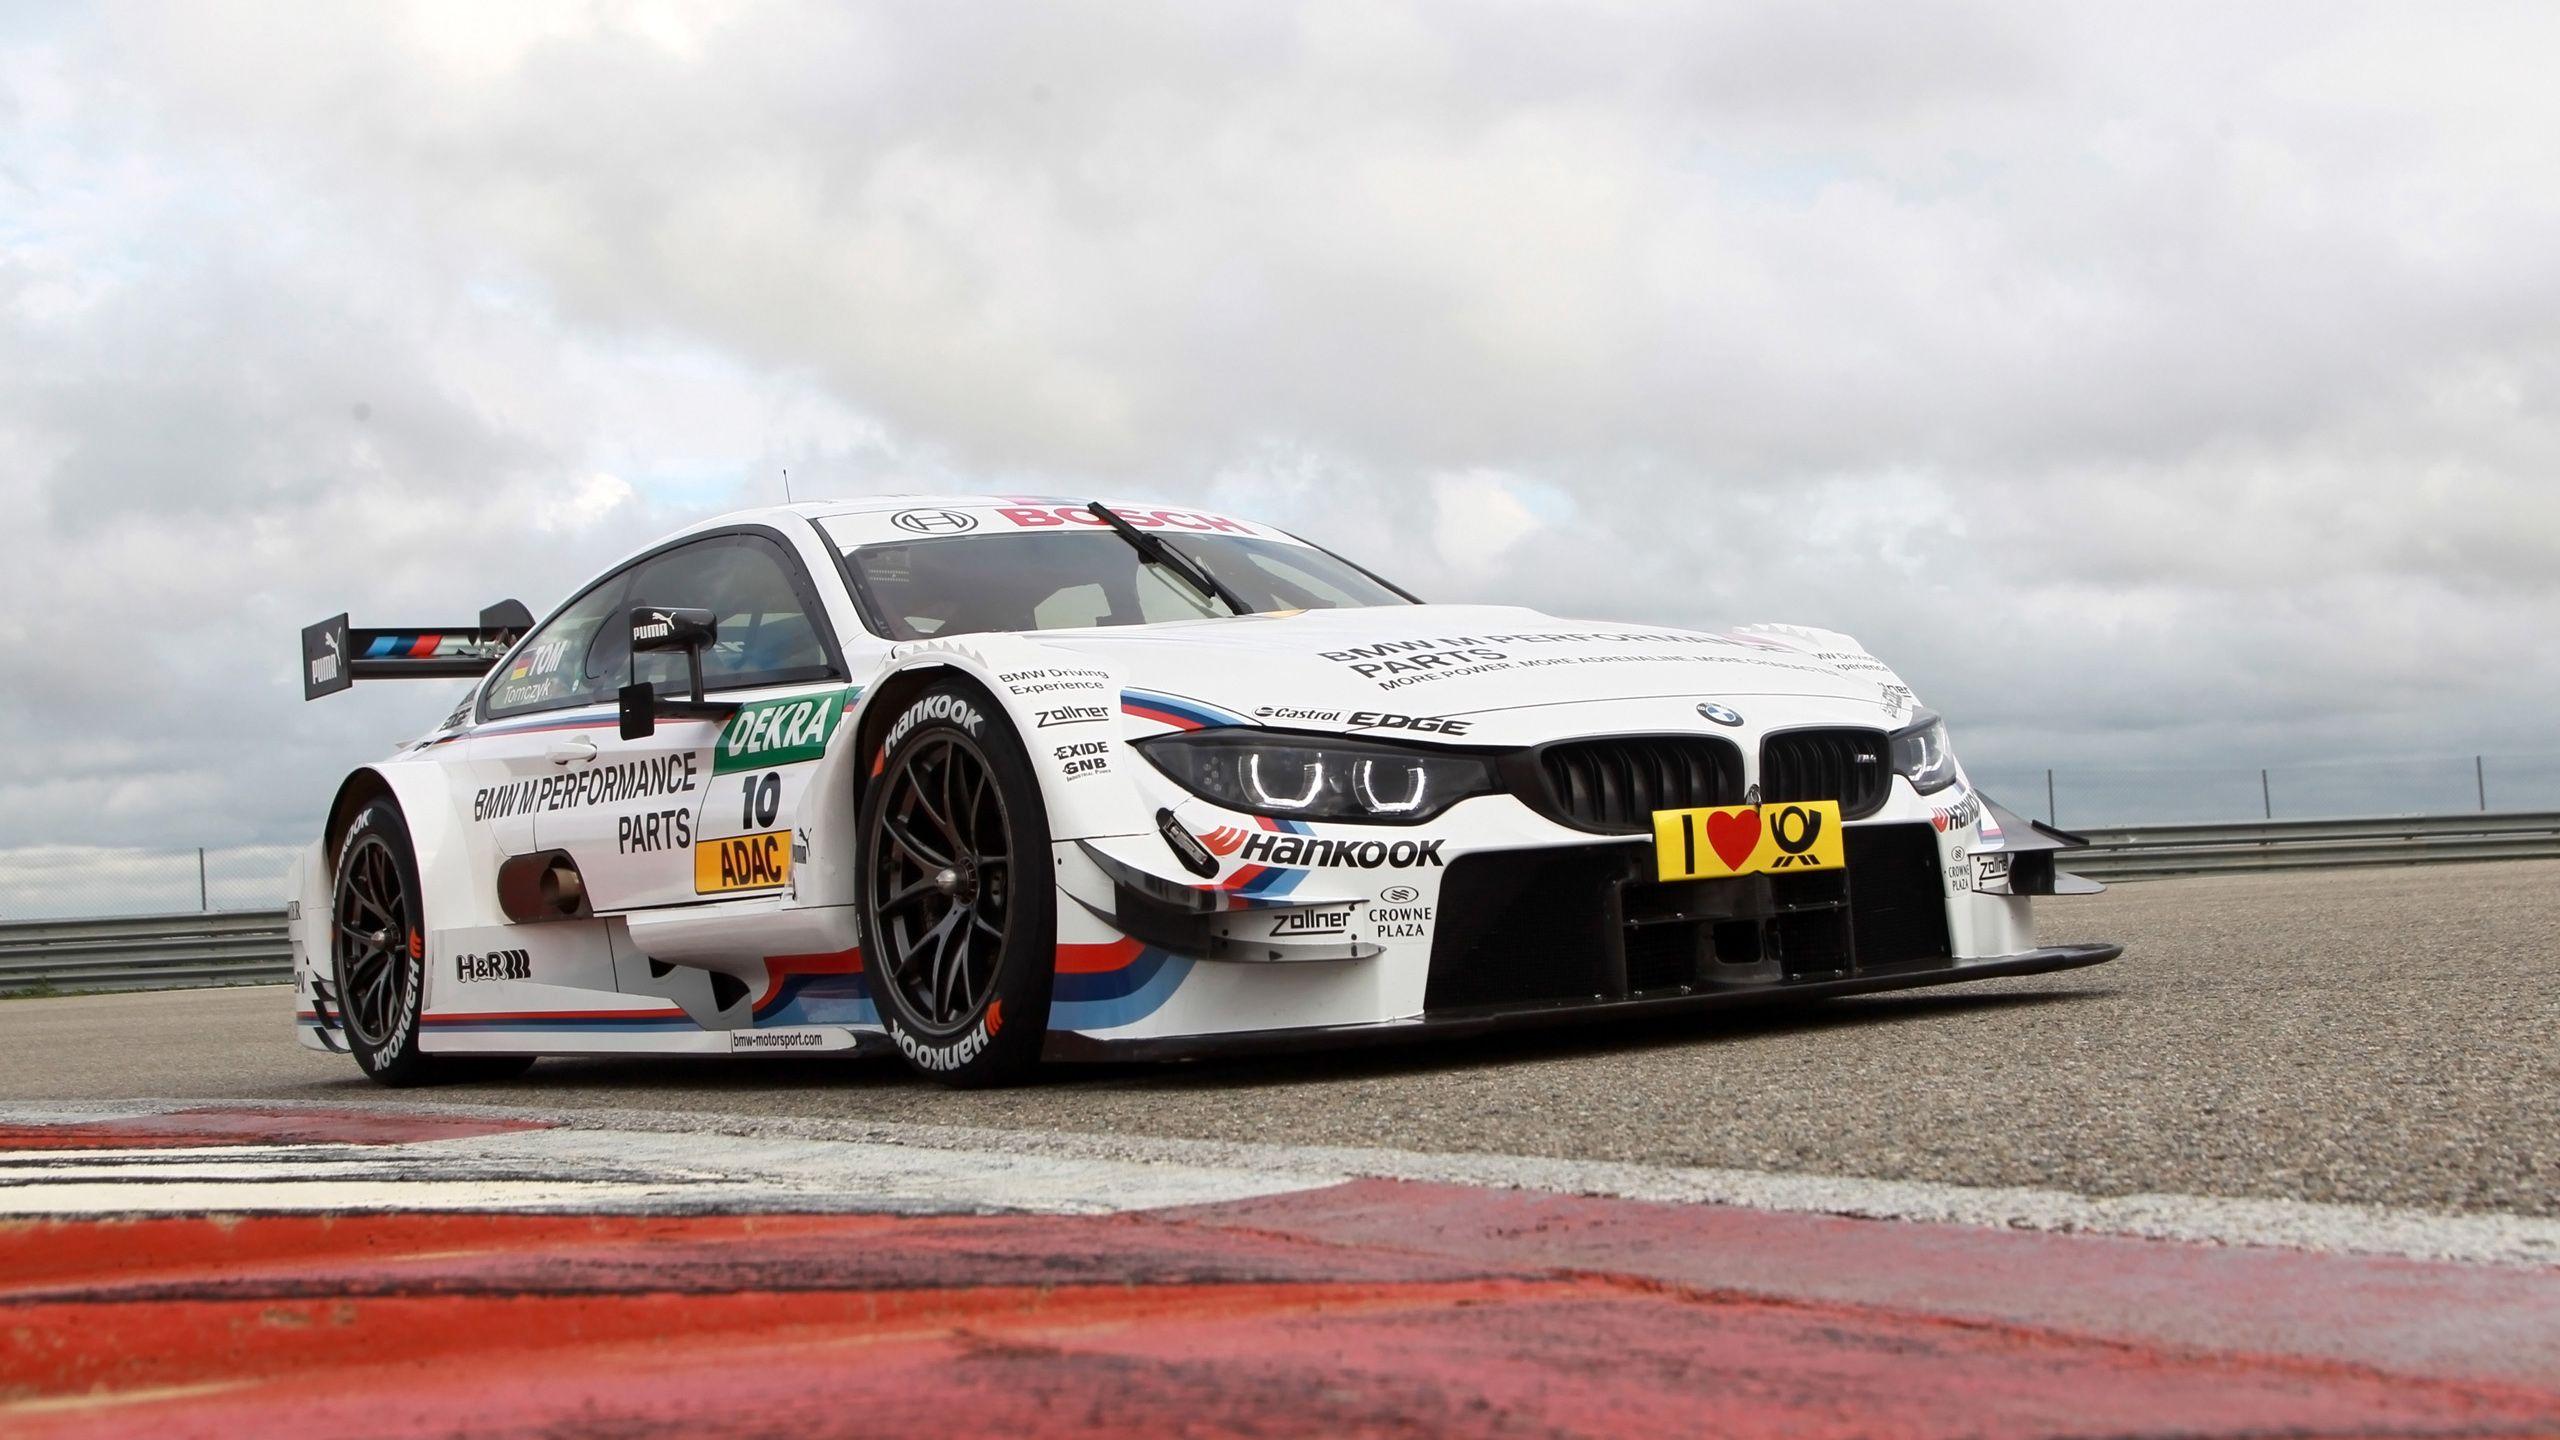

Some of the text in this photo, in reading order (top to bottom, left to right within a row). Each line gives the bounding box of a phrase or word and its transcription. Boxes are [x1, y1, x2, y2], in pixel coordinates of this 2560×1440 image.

[995, 508, 1257, 535] BOSCH
[633, 623, 668, 640] PUMA
[529, 640, 565, 677] TOM
[1317, 640, 1436, 661] BMW
[1436, 637, 1486, 647] M
[312, 654, 339, 684] PUMA
[998, 668, 1110, 683] BMW Driving
[1348, 648, 1508, 678] PARTS
[1378, 673, 1443, 691] MORE
[1519, 657, 1574, 668] MORE
[504, 678, 551, 704] Tomczyk
[1008, 680, 1104, 695] Experience
[729, 697, 832, 757] DEKRA
[1273, 705, 1474, 736] Castrol EDGE
[1053, 741, 1109, 760] EXIDE
[1063, 757, 1107, 774] GNB
[475, 751, 697, 822] BMW M PERFORMANCE
[743, 772, 781, 829] 10
[619, 807, 691, 854] PARTS
[1682, 814, 1695, 875] I
[721, 835, 782, 887] ADAC
[1949, 864, 1970, 878] CROWNE
[1952, 879, 1969, 891] PLAZA
[1369, 907, 1433, 922] CROWNE
[1377, 923, 1425, 938] PLAZA
[456, 952, 507, 983] H&R
[733, 1032, 823, 1049] bmw-motorsport.com
